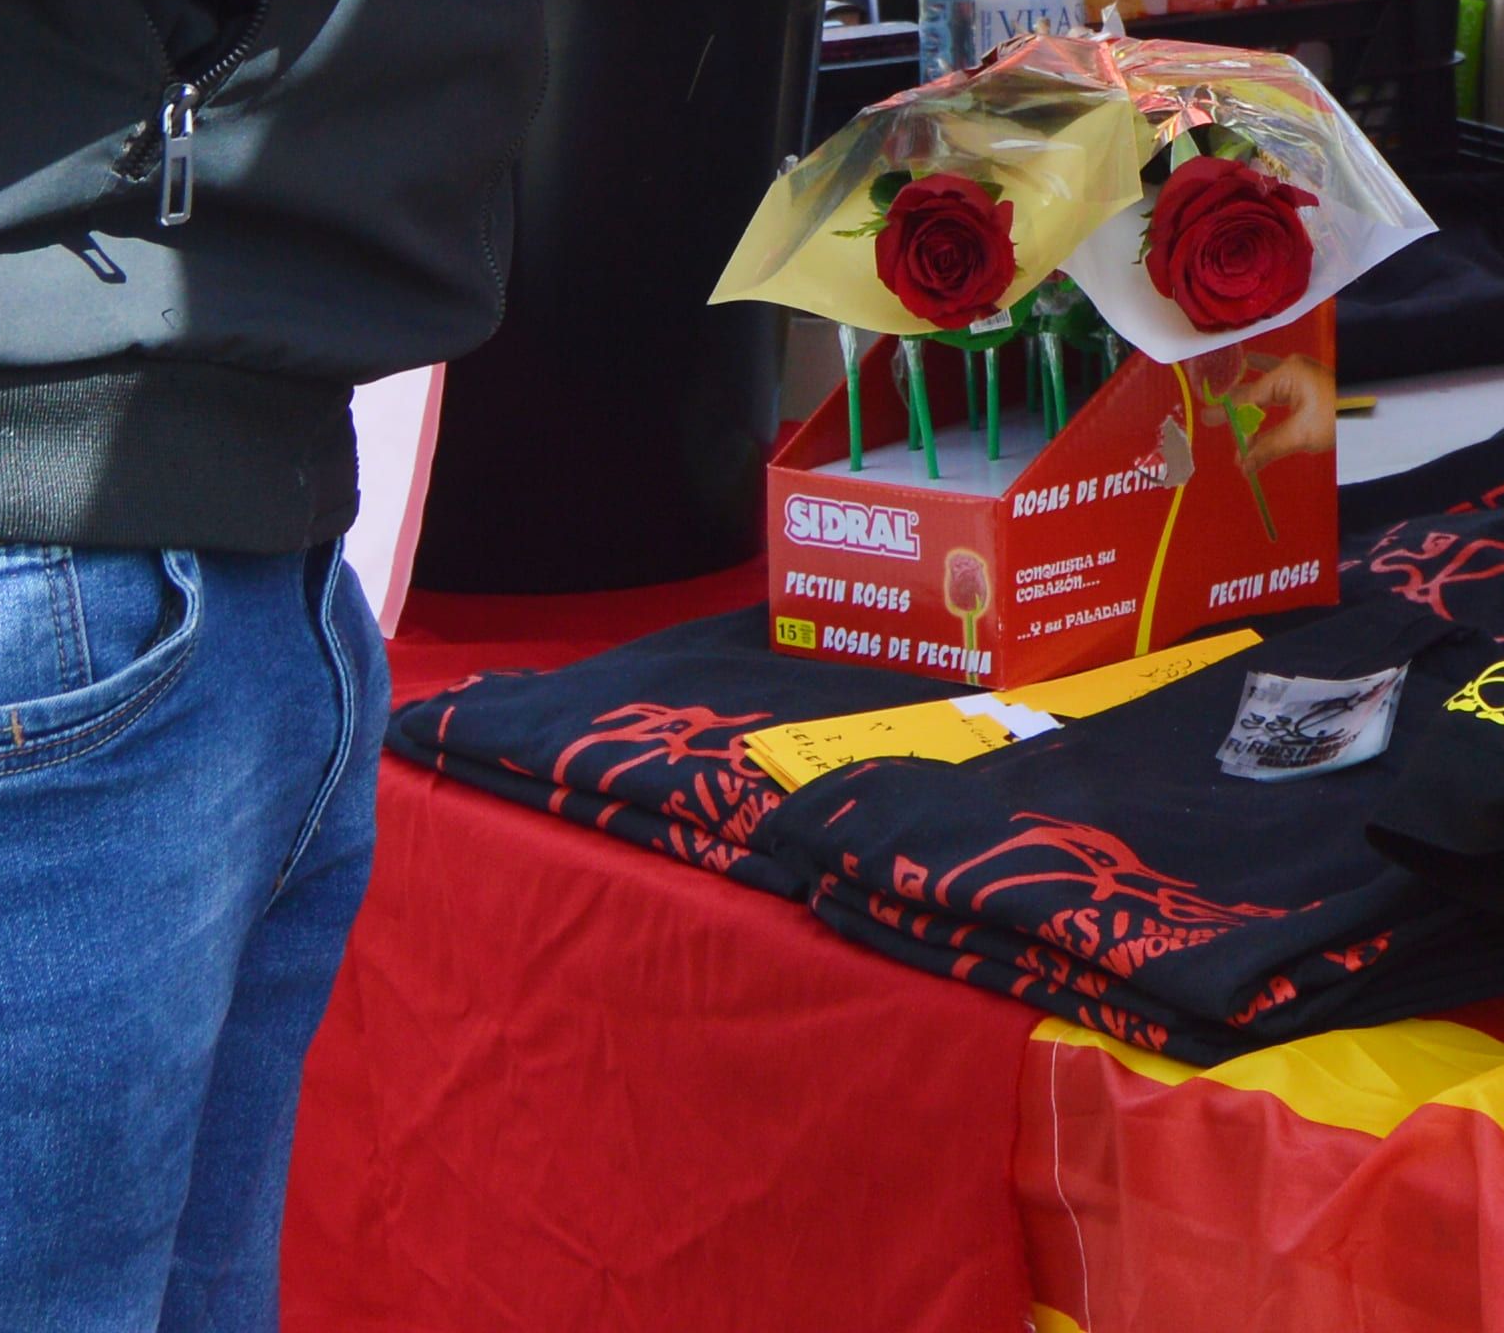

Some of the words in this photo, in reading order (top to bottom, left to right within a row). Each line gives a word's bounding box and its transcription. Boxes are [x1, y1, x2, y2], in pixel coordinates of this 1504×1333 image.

[1011, 483, 1071, 519] ROSAS
[1075, 476, 1099, 506] DE
[1015, 552, 1095, 585] CONQUISTA
[1208, 569, 1264, 610] PECTIN
[1268, 558, 1321, 594] ROSES
[784, 570, 846, 603] PECTIN
[851, 581, 912, 614] ROSES
[1064, 597, 1137, 630] PALADAR!
[777, 622, 798, 642] 15
[822, 625, 882, 658] ROSAS
[887, 635, 911, 662] DE
[916, 640, 993, 676] PECTINA
